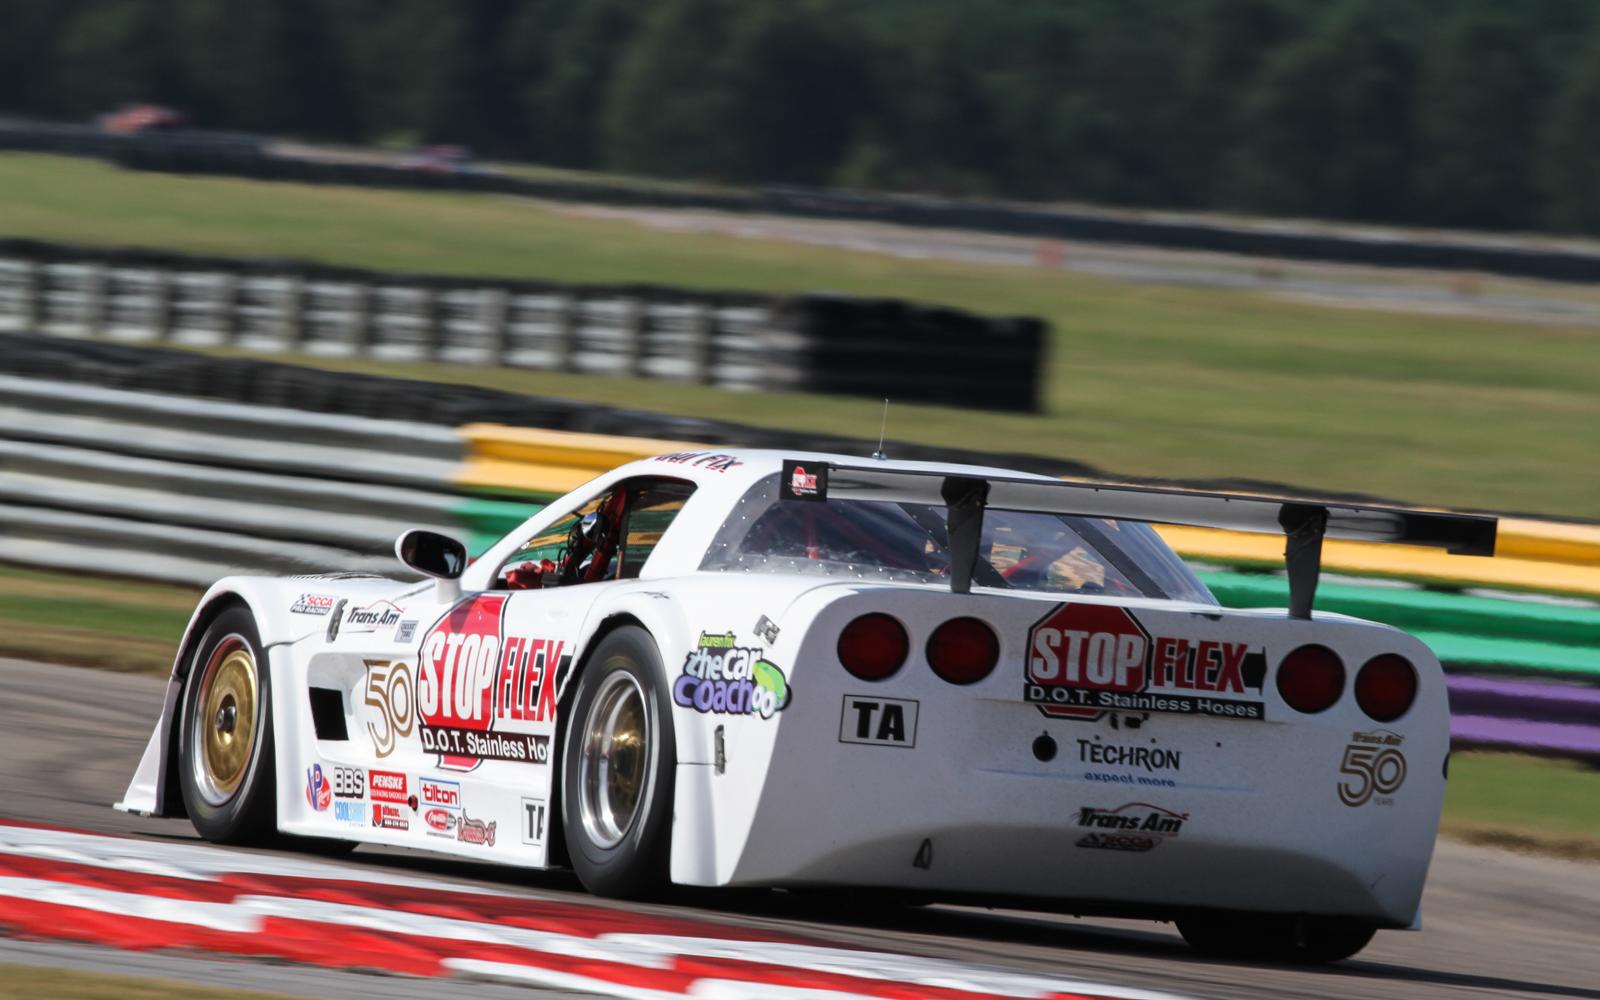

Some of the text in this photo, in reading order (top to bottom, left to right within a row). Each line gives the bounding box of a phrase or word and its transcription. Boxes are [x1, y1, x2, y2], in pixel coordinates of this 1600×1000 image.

[307, 596, 334, 607] SCCA
[347, 607, 400, 626] Trans Am
[420, 631, 565, 723] STOP FLEX
[687, 648, 762, 681] the Car
[1031, 628, 1248, 694] STOP FLEX
[362, 659, 415, 758] 50
[674, 674, 752, 714] Coach
[1030, 686, 1258, 717] D.O.T. Stainless Hoses
[852, 701, 906, 742] TA
[422, 727, 465, 753] D.O.T.
[466, 731, 526, 760] Stainless
[1077, 739, 1181, 772] TECHRON
[333, 766, 364, 799] BBS
[372, 774, 404, 790] PENSKE
[1085, 772, 1134, 784] expect
[1337, 744, 1407, 807] 50
[423, 783, 459, 806] tilton
[1078, 806, 1182, 833] Trans Am
